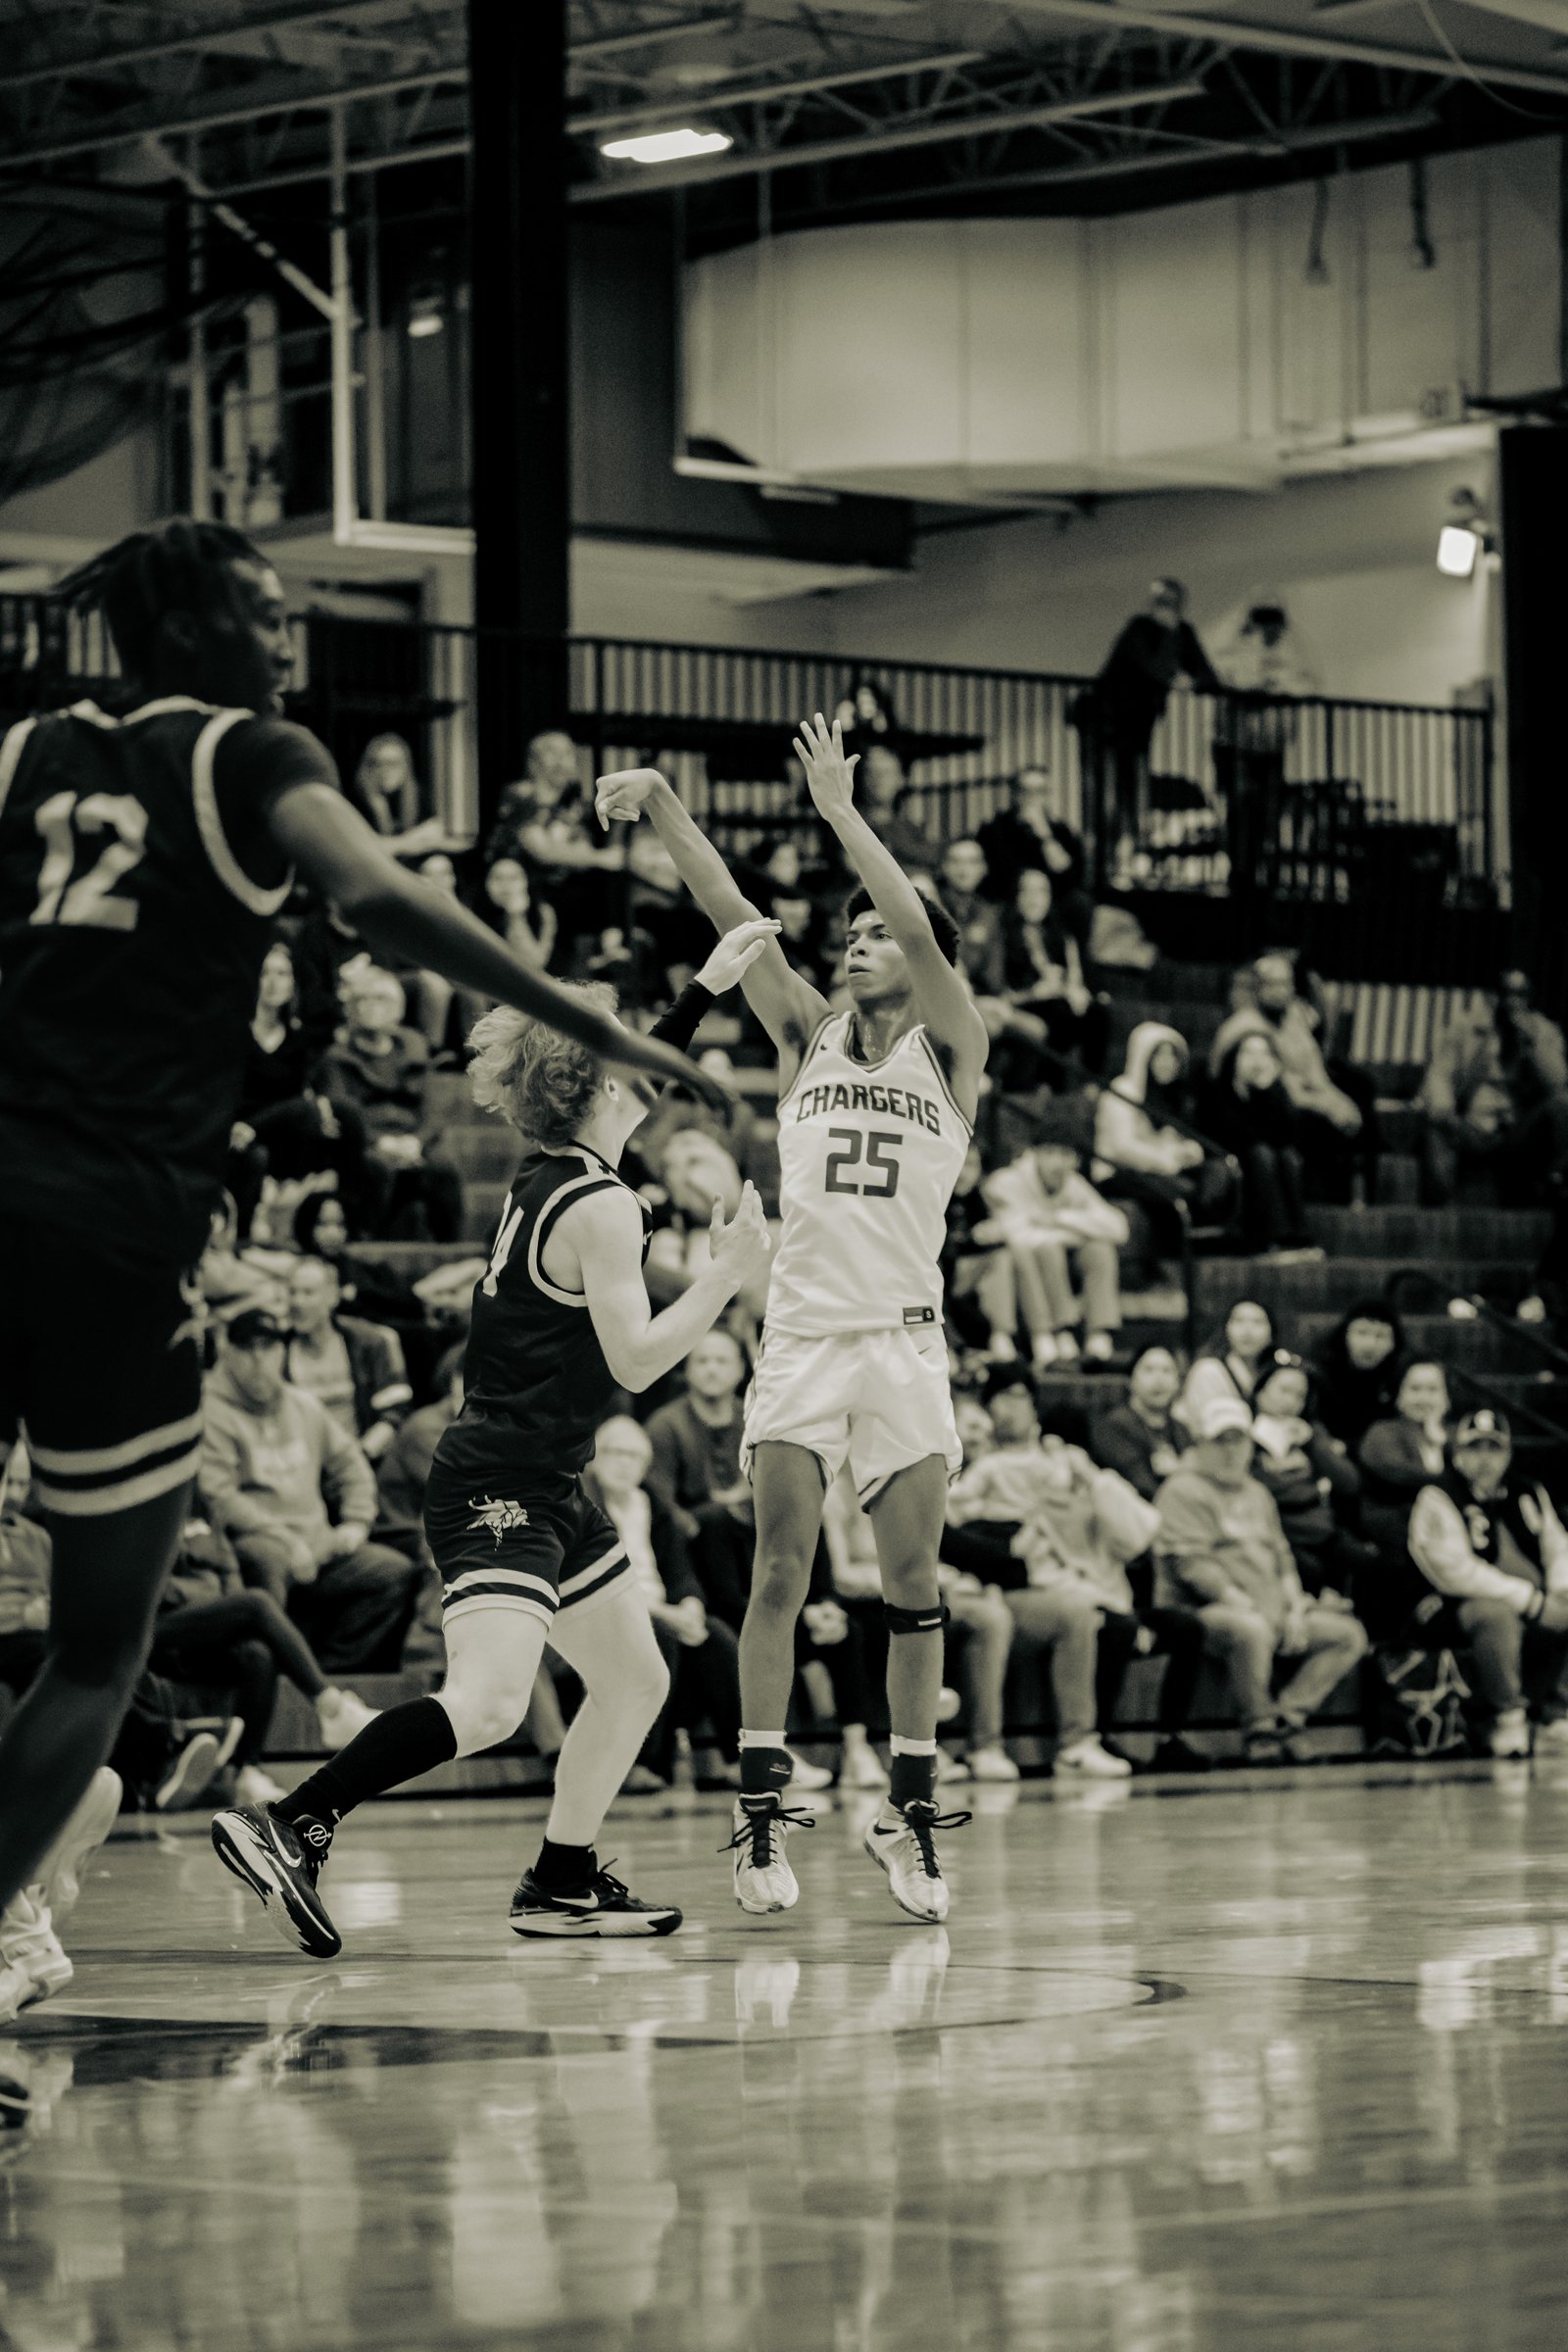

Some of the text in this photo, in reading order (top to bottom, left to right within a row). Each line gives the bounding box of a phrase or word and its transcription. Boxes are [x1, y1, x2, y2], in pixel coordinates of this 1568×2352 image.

[28, 790, 148, 931] 12
[797, 1084, 941, 1136] CHARGERS
[825, 1128, 904, 1198] 25
